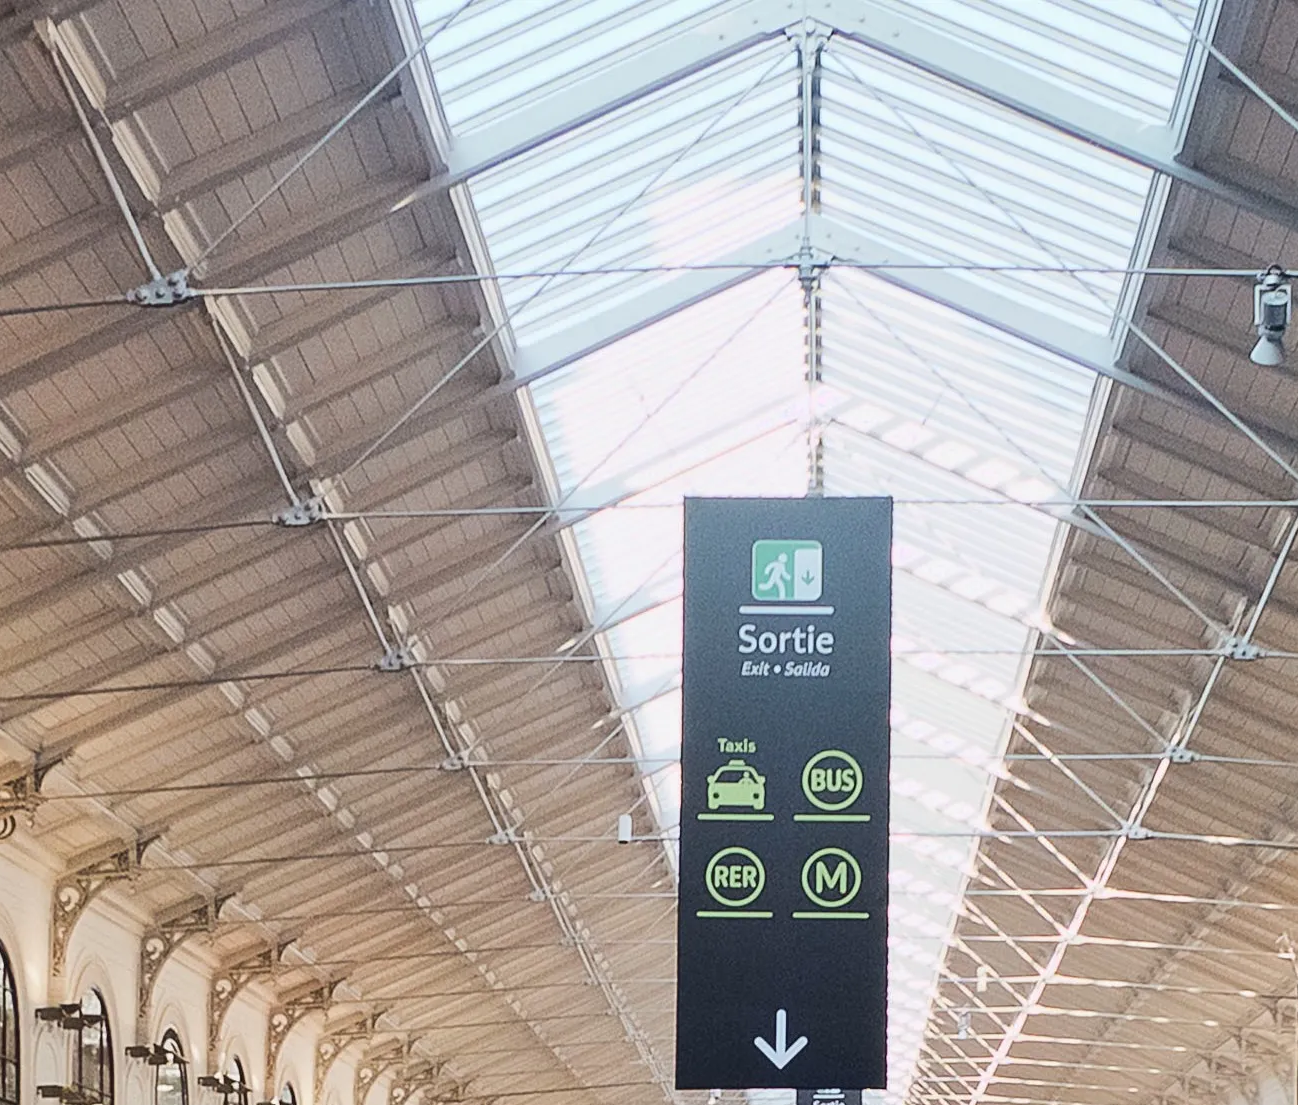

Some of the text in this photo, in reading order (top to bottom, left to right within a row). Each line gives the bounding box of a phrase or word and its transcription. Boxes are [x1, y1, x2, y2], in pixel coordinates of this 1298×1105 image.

[738, 623, 834, 654] Sortie
[741, 661, 830, 677] Exit Salida
[717, 738, 757, 753] Taxis
[810, 768, 855, 793] BUS
[714, 861, 848, 894] RER M
